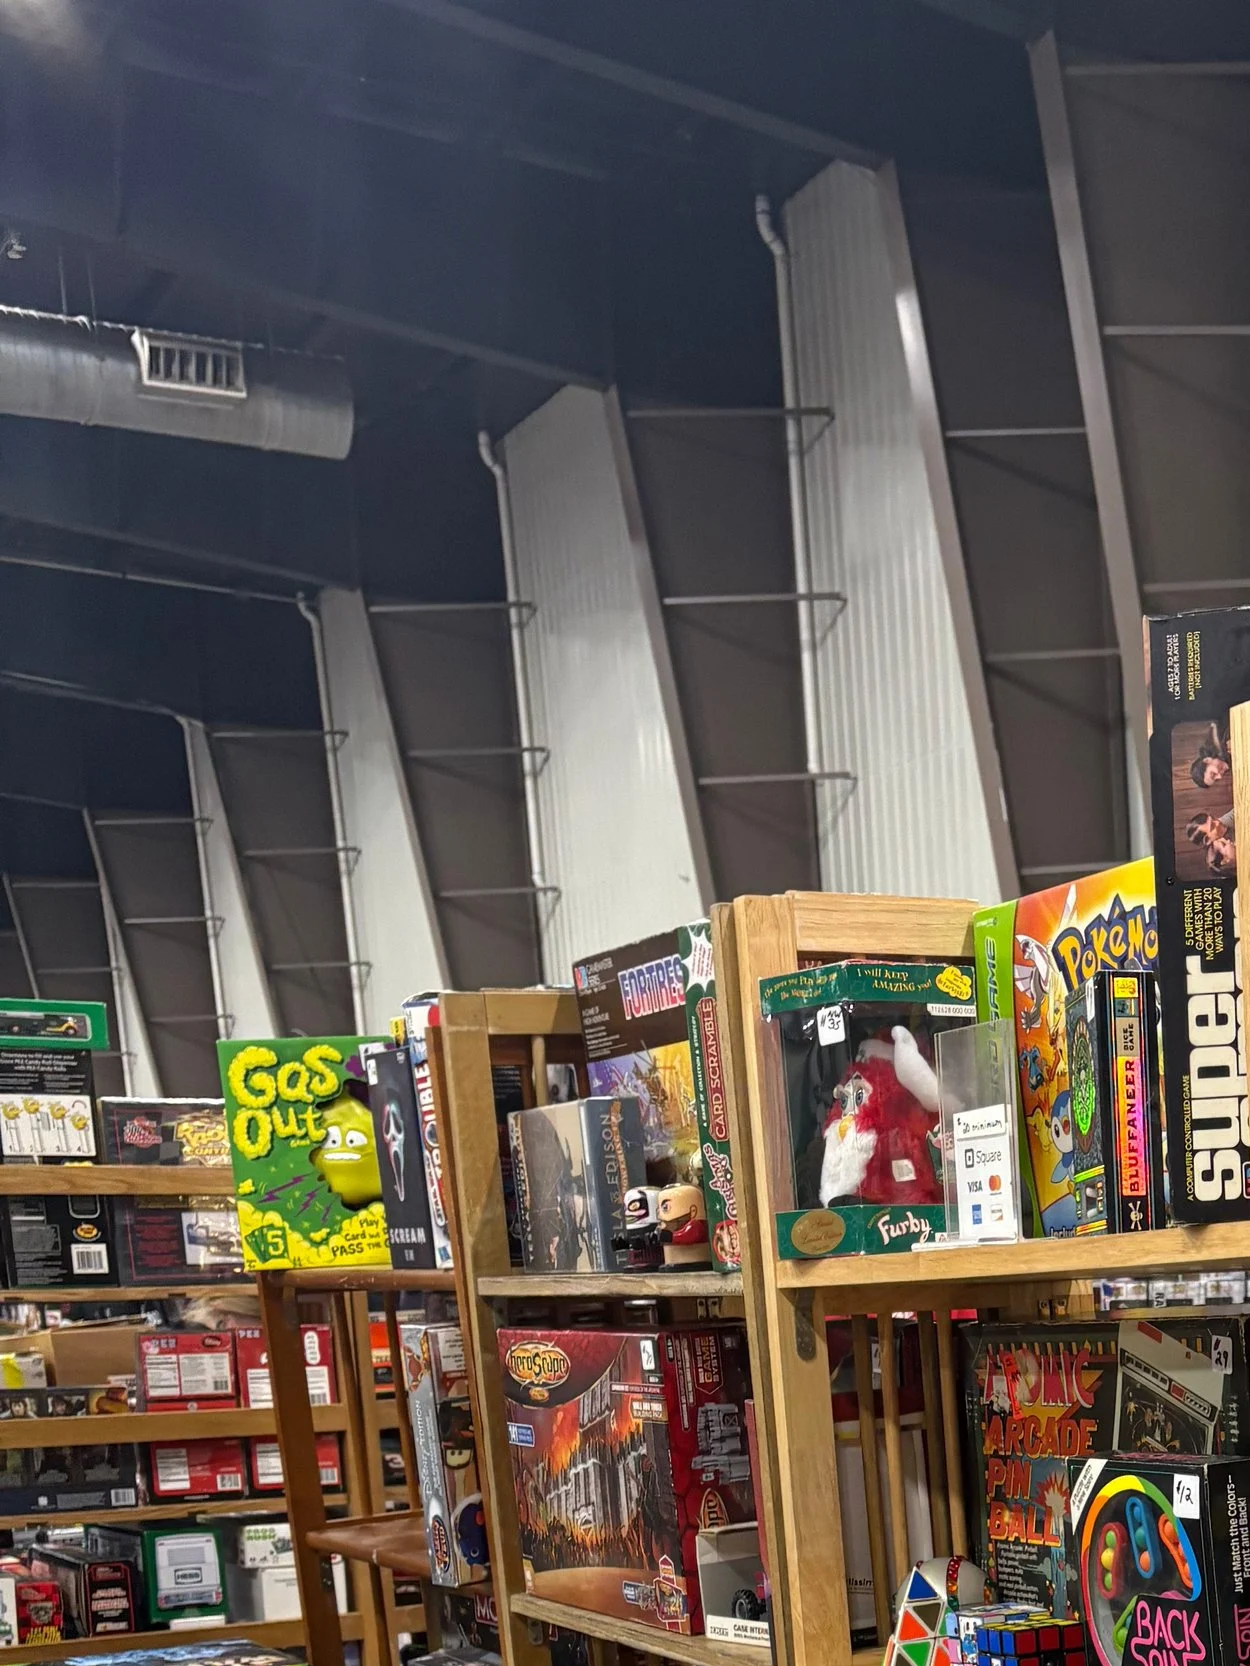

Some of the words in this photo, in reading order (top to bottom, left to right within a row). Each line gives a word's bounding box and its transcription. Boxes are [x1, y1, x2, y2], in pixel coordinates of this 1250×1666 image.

[1184, 889, 1194, 939] DIFFERENT
[1194, 888, 1203, 914] WITH
[871, 979, 916, 993] AMAZING
[984, 935, 999, 1033] GAME
[702, 998, 723, 1091] SCRAMBLE
[228, 1044, 343, 1109] Gas
[1186, 954, 1248, 1202] super
[232, 1105, 329, 1161] Out
[711, 1093, 727, 1139] CARD
[1123, 1059, 1140, 1193] BLUFFANEER
[1185, 1100, 1193, 1149] CONTROLLED
[598, 1113, 619, 1186] EDISON
[975, 1147, 1003, 1167] Square
[967, 1180, 983, 1194] VISA
[1186, 1150, 1195, 1191] COMPUTER
[266, 1230, 284, 1257] 5
[331, 1241, 364, 1257] PASS
[388, 1227, 427, 1243] SCREAM
[876, 1211, 934, 1246] Furby
[984, 1417, 1099, 1459] ARCADE
[986, 1459, 1032, 1501] PIN
[987, 1504, 1062, 1547] BALL
[1231, 1520, 1240, 1538] the
[1239, 1497, 1248, 1530] Back!
[1233, 1540, 1243, 1571] Match
[1241, 1531, 1250, 1550] and
[1235, 1572, 1245, 1594] Just
[1136, 1600, 1206, 1660] BACK
